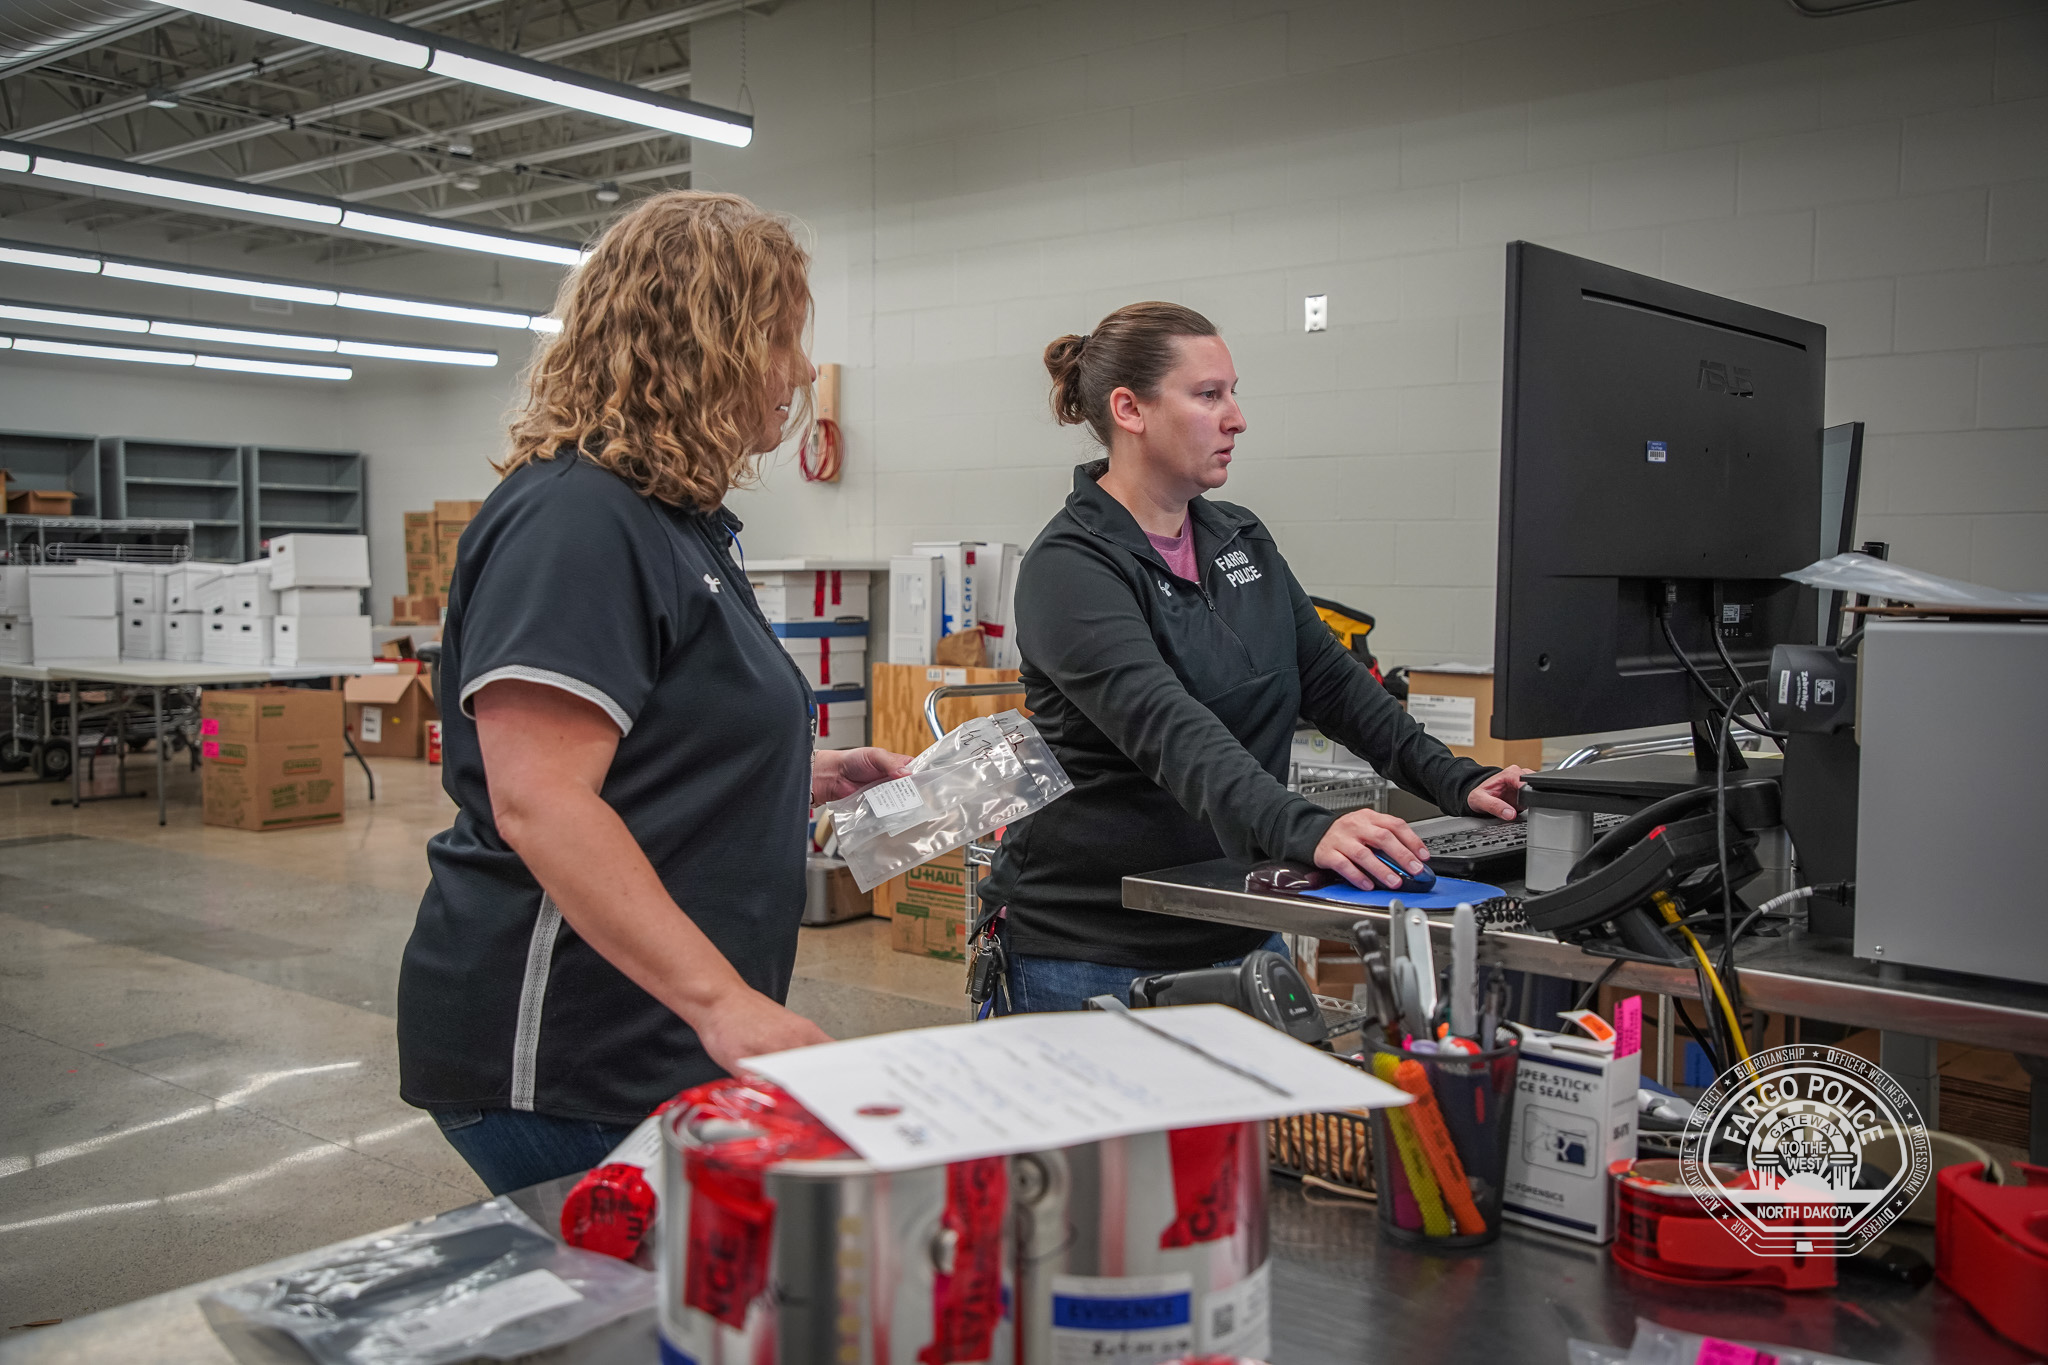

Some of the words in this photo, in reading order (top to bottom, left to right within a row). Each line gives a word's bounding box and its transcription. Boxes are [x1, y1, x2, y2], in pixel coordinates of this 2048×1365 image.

[1214, 550, 1249, 572] FARGO
[1225, 565, 1262, 588] POLICE
[963, 577, 972, 612] Care
[910, 867, 964, 887] U-HAUL
[1539, 1083, 1580, 1103] SEALS
